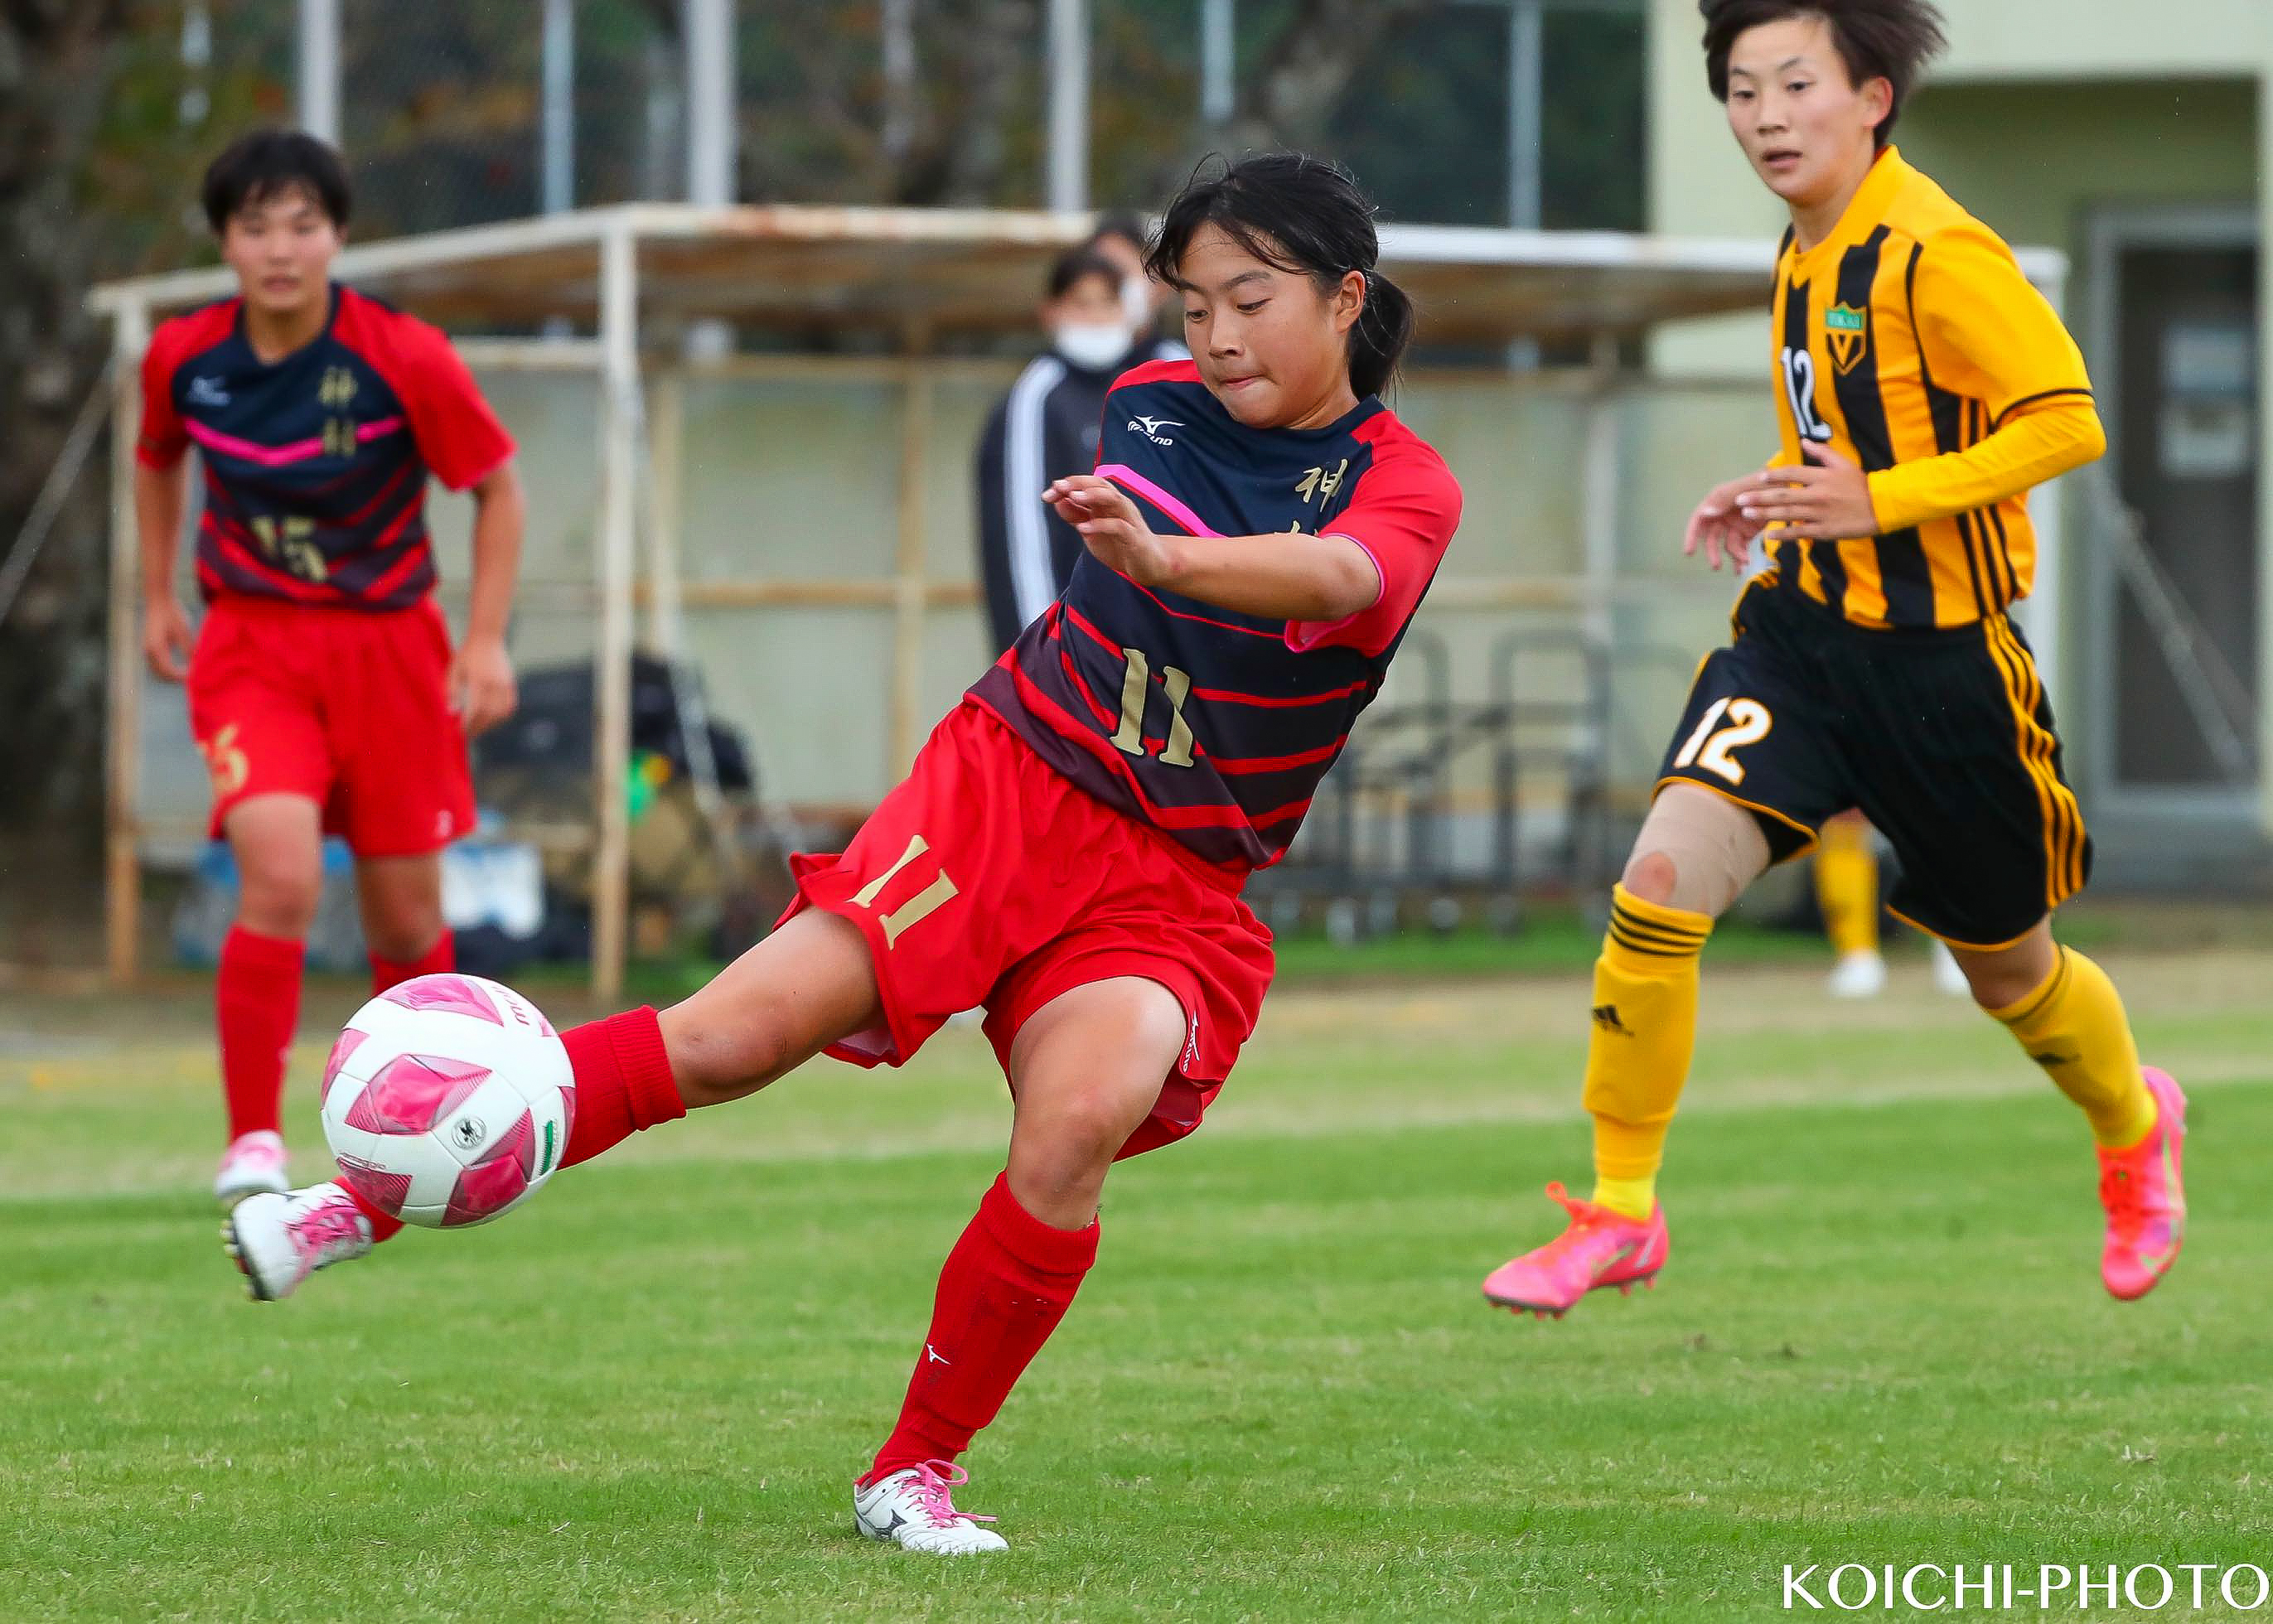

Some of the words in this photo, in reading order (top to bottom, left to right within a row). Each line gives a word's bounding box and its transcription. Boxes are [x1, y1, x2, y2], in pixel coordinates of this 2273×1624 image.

[1781, 346, 1832, 440] 12
[1284, 458, 1348, 537] 神
[252, 515, 330, 582] 15
[1110, 647, 1195, 767] 11
[1671, 694, 1773, 786] 12
[844, 834, 960, 951] 11
